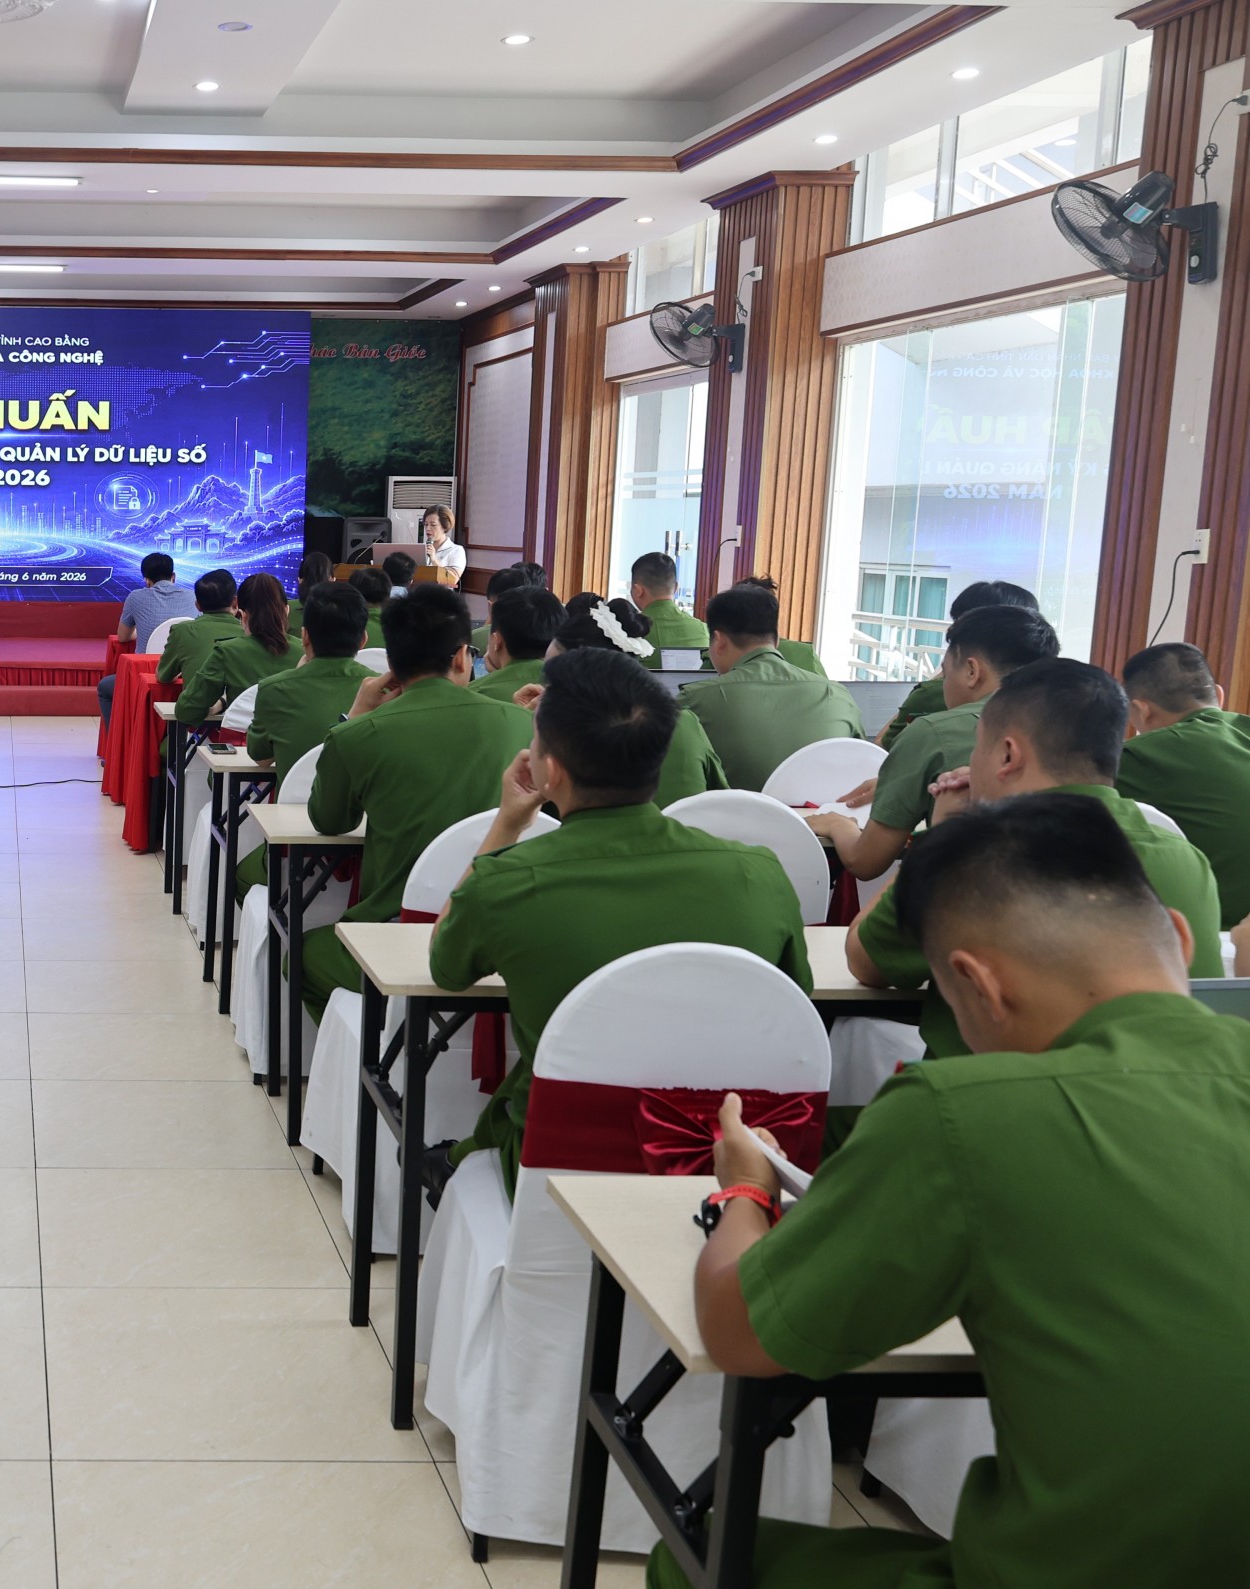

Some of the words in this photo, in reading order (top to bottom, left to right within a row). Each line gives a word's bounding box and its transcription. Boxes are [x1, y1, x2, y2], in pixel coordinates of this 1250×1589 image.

[25, 336, 51, 346] CAO
[55, 333, 90, 347] BẰNG
[8, 349, 56, 363] CÔNG
[60, 350, 104, 366] NGHỆ
[342, 343, 380, 359] Bản
[384, 343, 427, 362] Giốc
[0, 443, 61, 462] QUẢN
[67, 444, 90, 462] LÝ
[94, 444, 125, 462] DỮ
[129, 447, 172, 466] LIỆU
[177, 443, 207, 463] SỐ
[22, 572, 29, 581] 6
[32, 571, 57, 581] năm
[60, 572, 87, 581] 2026
